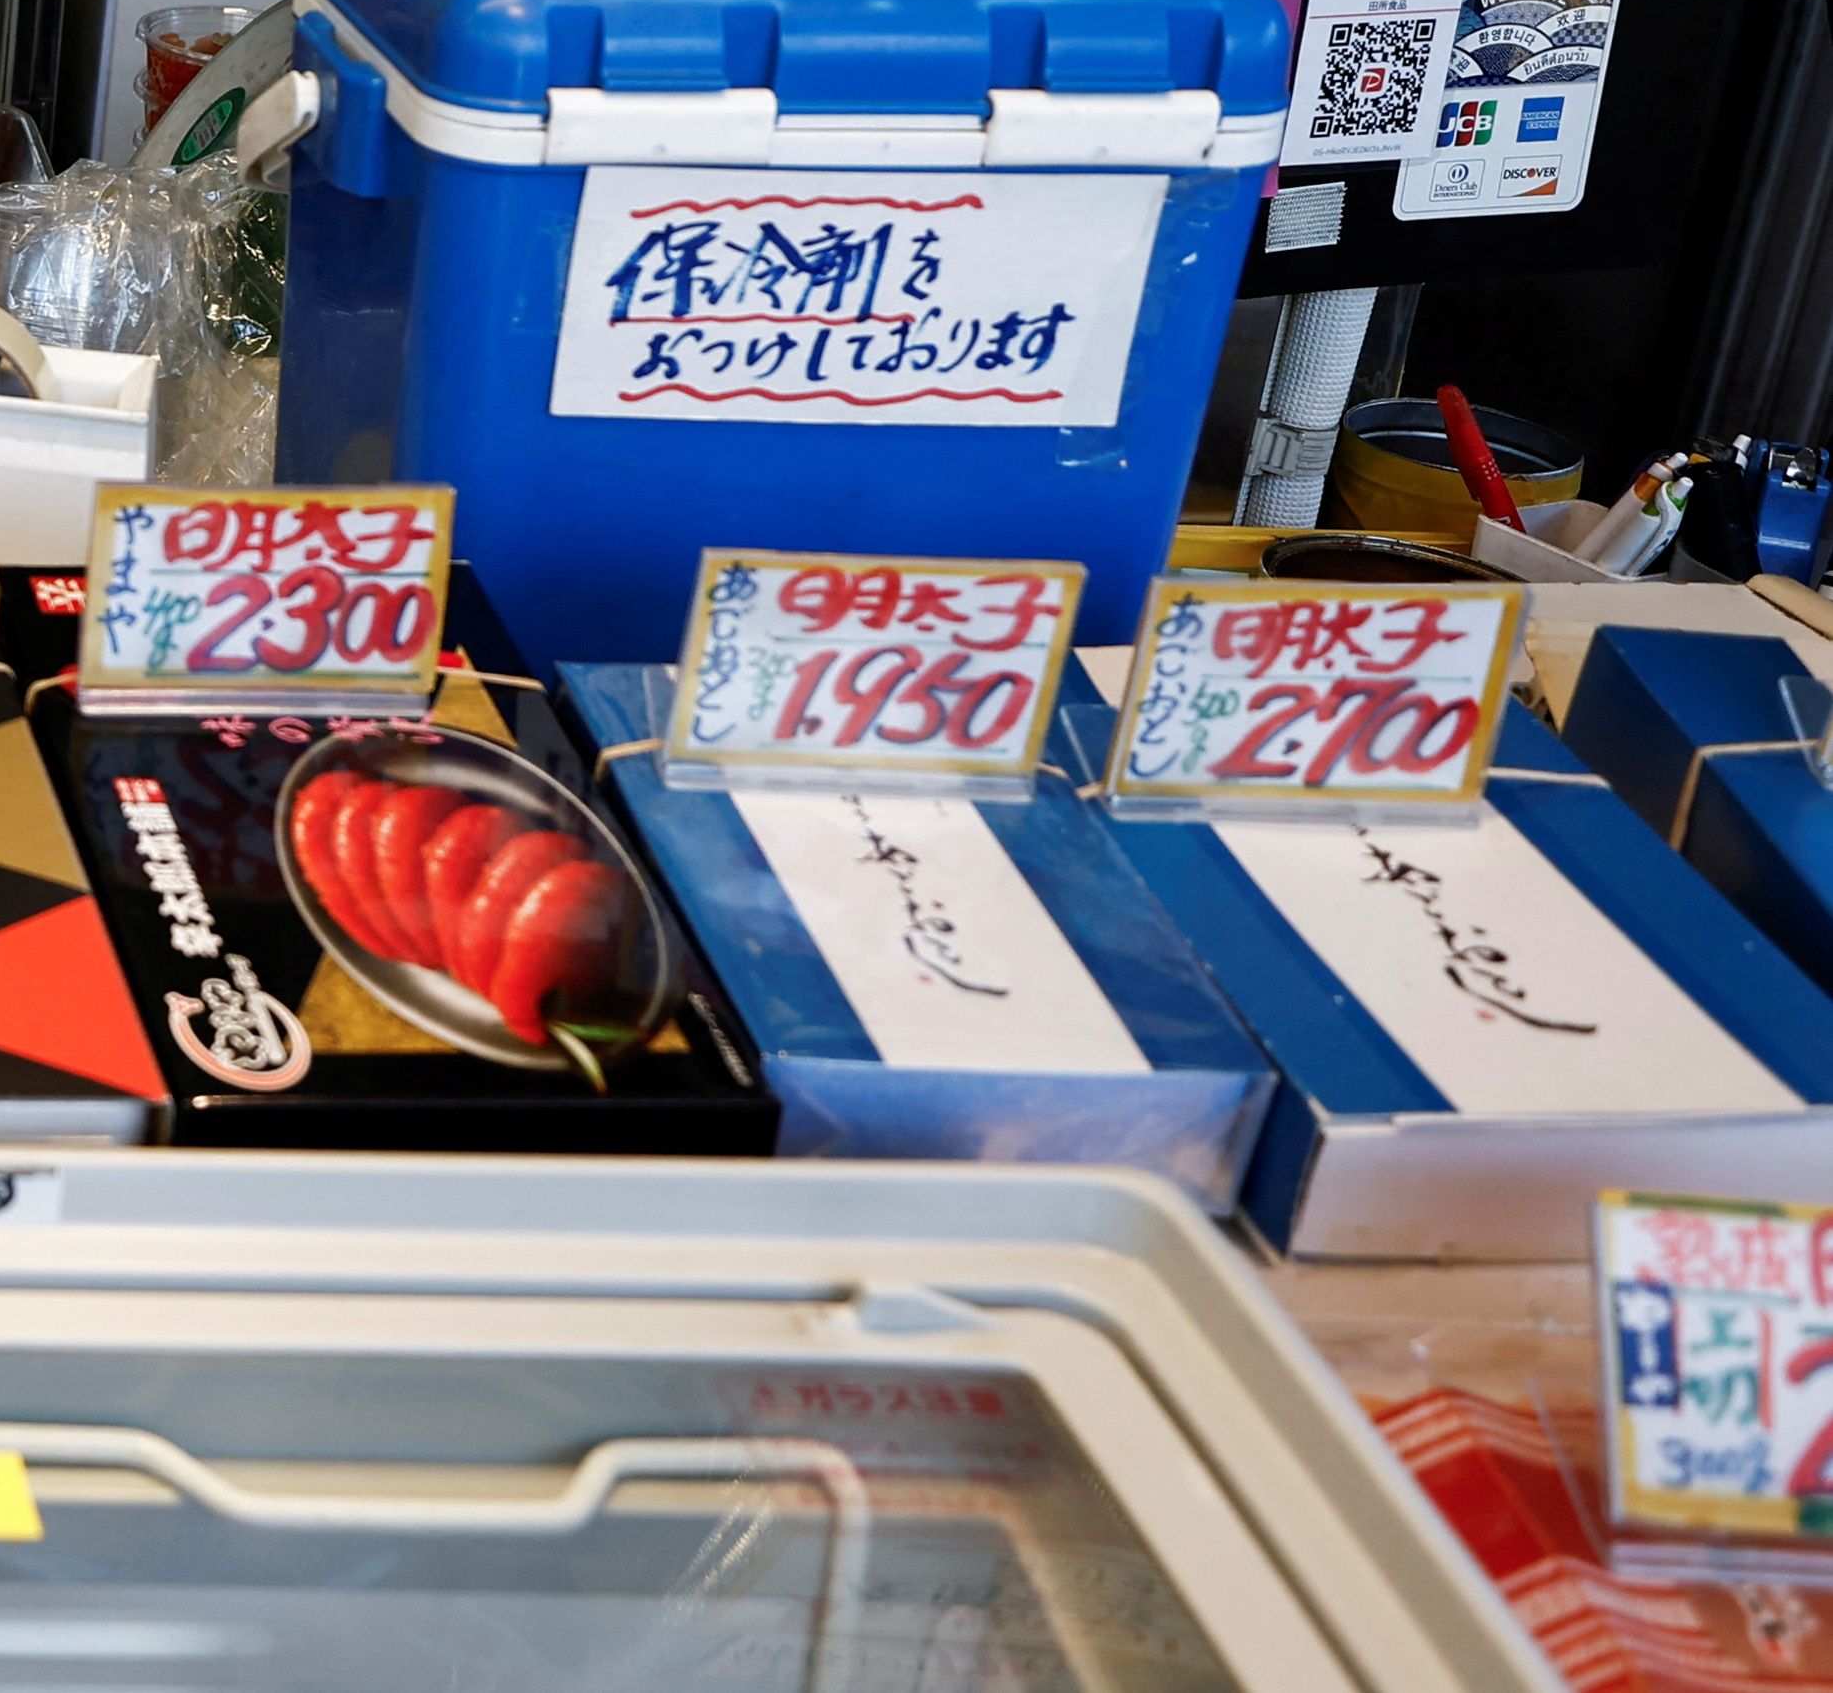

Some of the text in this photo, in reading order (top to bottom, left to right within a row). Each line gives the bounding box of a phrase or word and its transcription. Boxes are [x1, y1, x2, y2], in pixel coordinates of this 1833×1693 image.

[1368, 0, 1408, 12] 田所食品
[1557, 9, 1587, 27] 欢迎
[1478, 28, 1537, 48] 환영합니다
[1438, 115, 1493, 134] JCB
[1523, 111, 1559, 121] AMERICAN
[1526, 120, 1561, 130] EXPRESS
[1503, 167, 1557, 180] DISCOVER
[1433, 190, 1477, 198] INTERNATIONAL
[1434, 180, 1478, 191] Diners Club
[604, 221, 941, 323] 保冷剤を
[633, 302, 1076, 383] おつけしております
[163, 500, 436, 572] 明太子
[97, 505, 155, 654] やまや
[778, 566, 1063, 651] 明太子
[1211, 597, 1467, 678] 明太子
